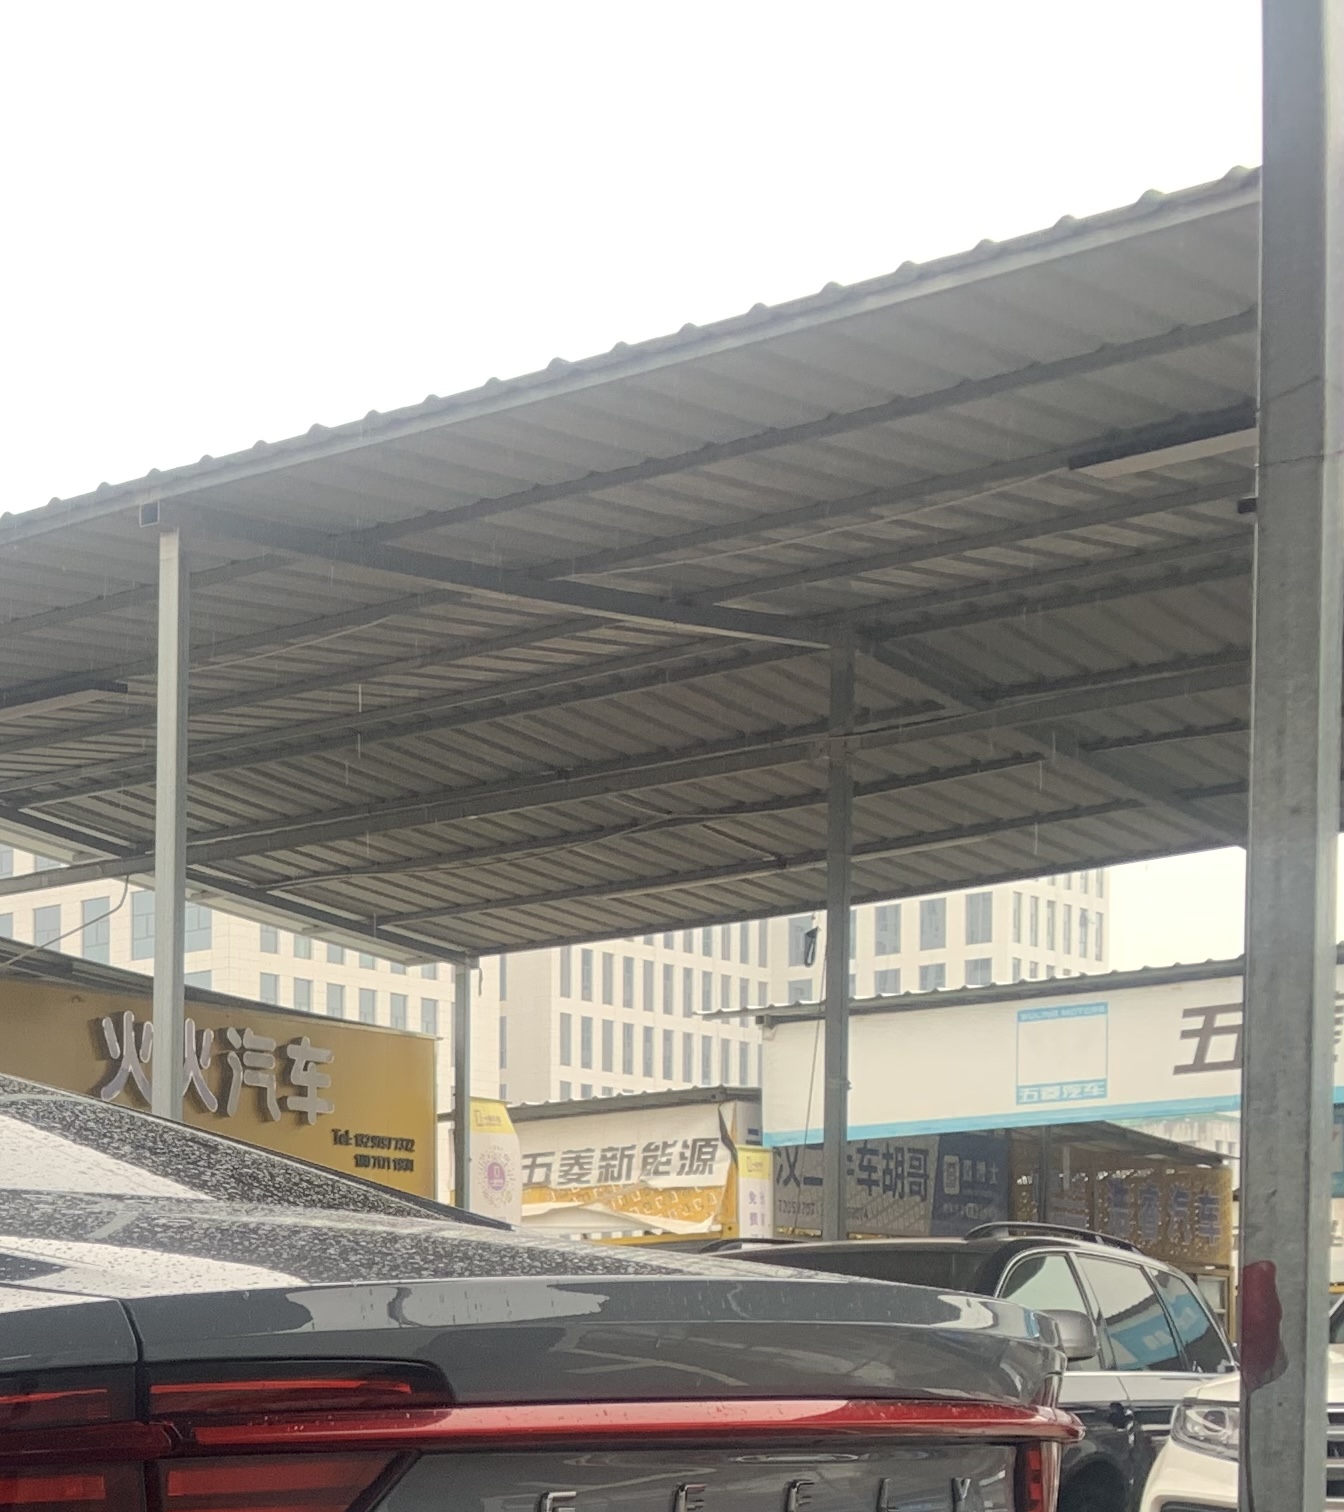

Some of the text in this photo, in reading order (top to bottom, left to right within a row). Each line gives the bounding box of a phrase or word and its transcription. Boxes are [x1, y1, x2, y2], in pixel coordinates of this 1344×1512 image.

[99, 1009, 336, 1126] 火火汽车
[522, 1137, 720, 1186] 五菱新能源
